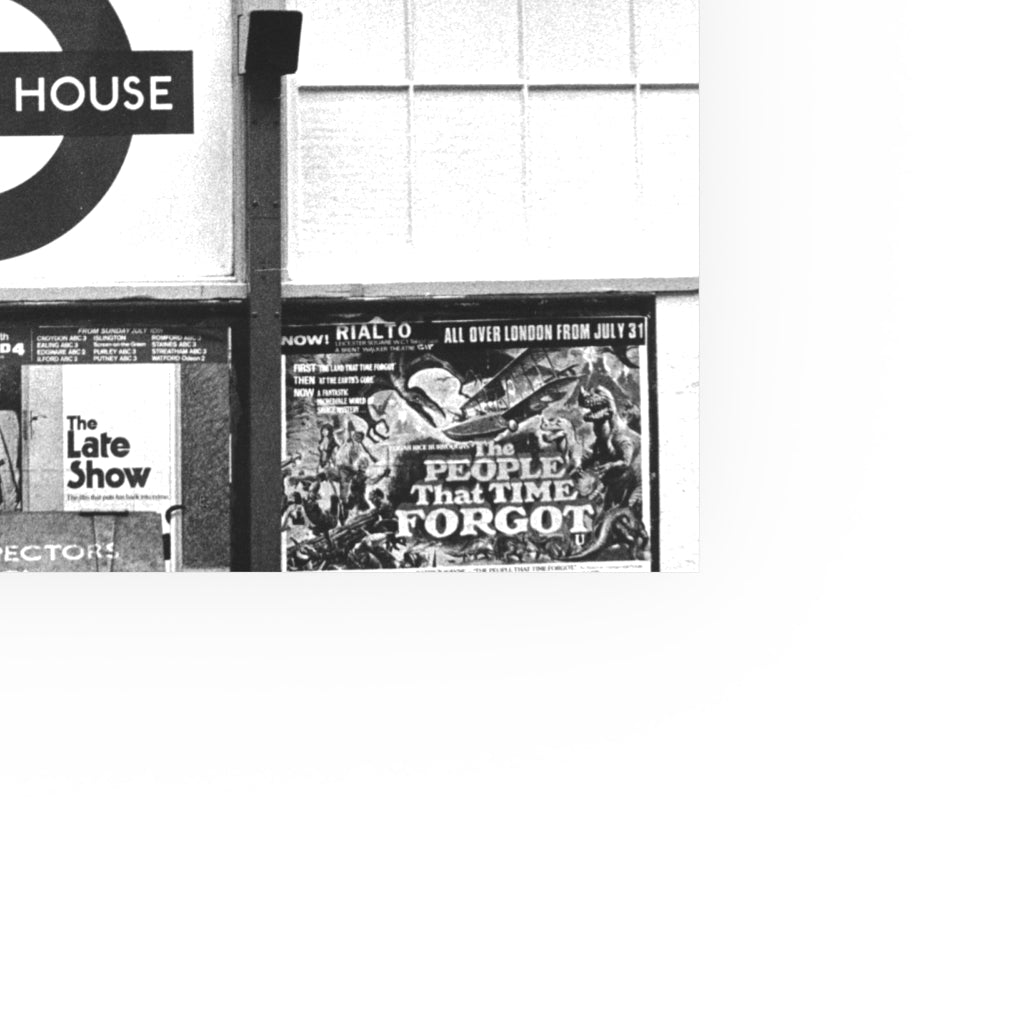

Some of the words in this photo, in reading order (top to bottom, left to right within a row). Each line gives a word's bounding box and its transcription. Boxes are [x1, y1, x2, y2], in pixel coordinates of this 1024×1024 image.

[15, 76, 173, 112] HOUSE
[336, 323, 412, 340] RIALTO
[444, 327, 464, 343] ALL
[469, 326, 501, 342] OVER
[504, 325, 553, 342] LONDON
[556, 324, 591, 341] FROM
[594, 323, 625, 339] JULY
[628, 323, 644, 339] 31
[12, 342, 25, 356] 4
[282, 335, 330, 346] NOW!
[293, 363, 316, 373] FIRST
[293, 376, 315, 385] THEN
[293, 388, 314, 397] NOW
[66, 415, 98, 430] The
[67, 430, 130, 458] Late
[475, 440, 515, 456] The
[67, 460, 151, 489] Show
[424, 456, 566, 482] PEOPLE
[410, 483, 485, 506] That
[488, 479, 578, 505] TIME
[395, 504, 594, 539] FORGOT
